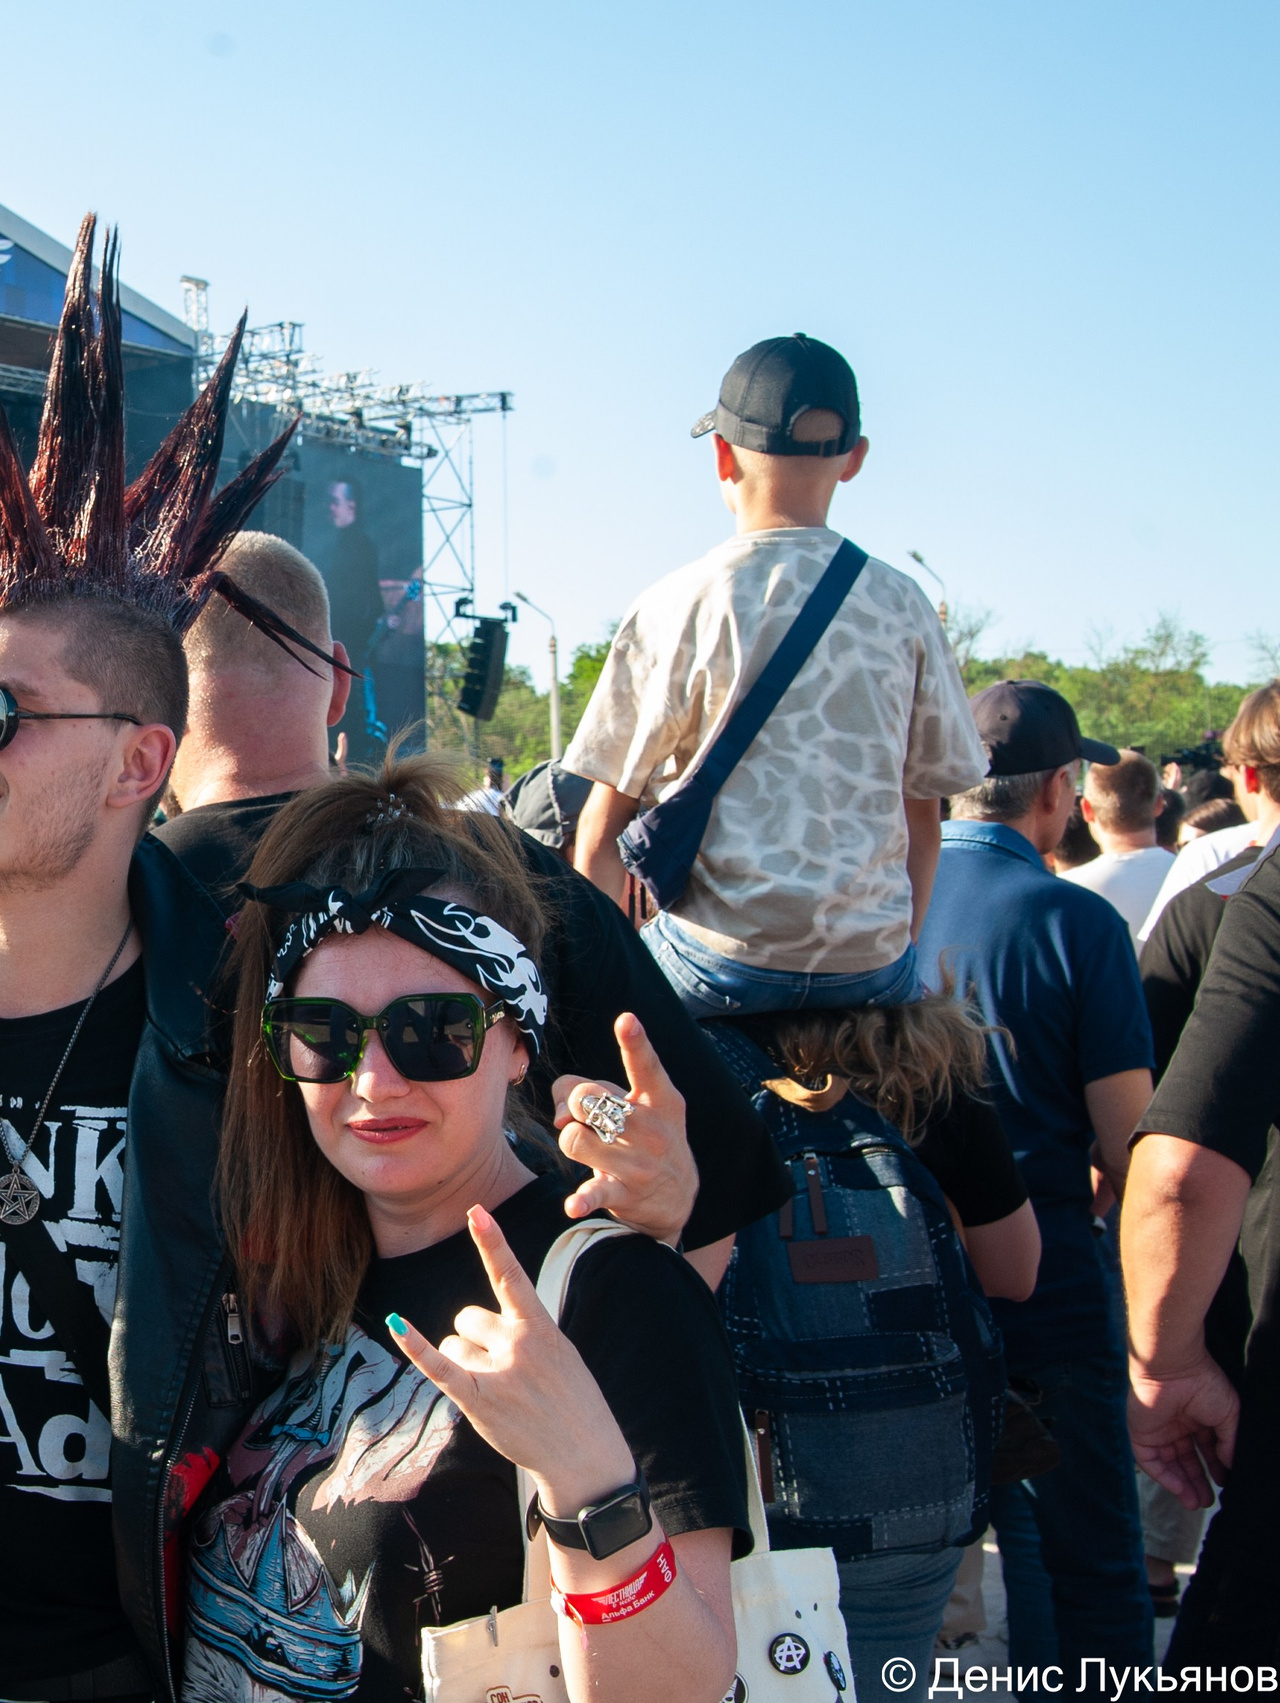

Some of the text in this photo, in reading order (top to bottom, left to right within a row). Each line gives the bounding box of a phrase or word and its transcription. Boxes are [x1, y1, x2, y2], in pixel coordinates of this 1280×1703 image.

[657, 1553, 673, 1583] ФАН
[601, 1590, 655, 1622] Альфа Банк
[605, 1578, 640, 1605] ЛЕСТНИЦА
